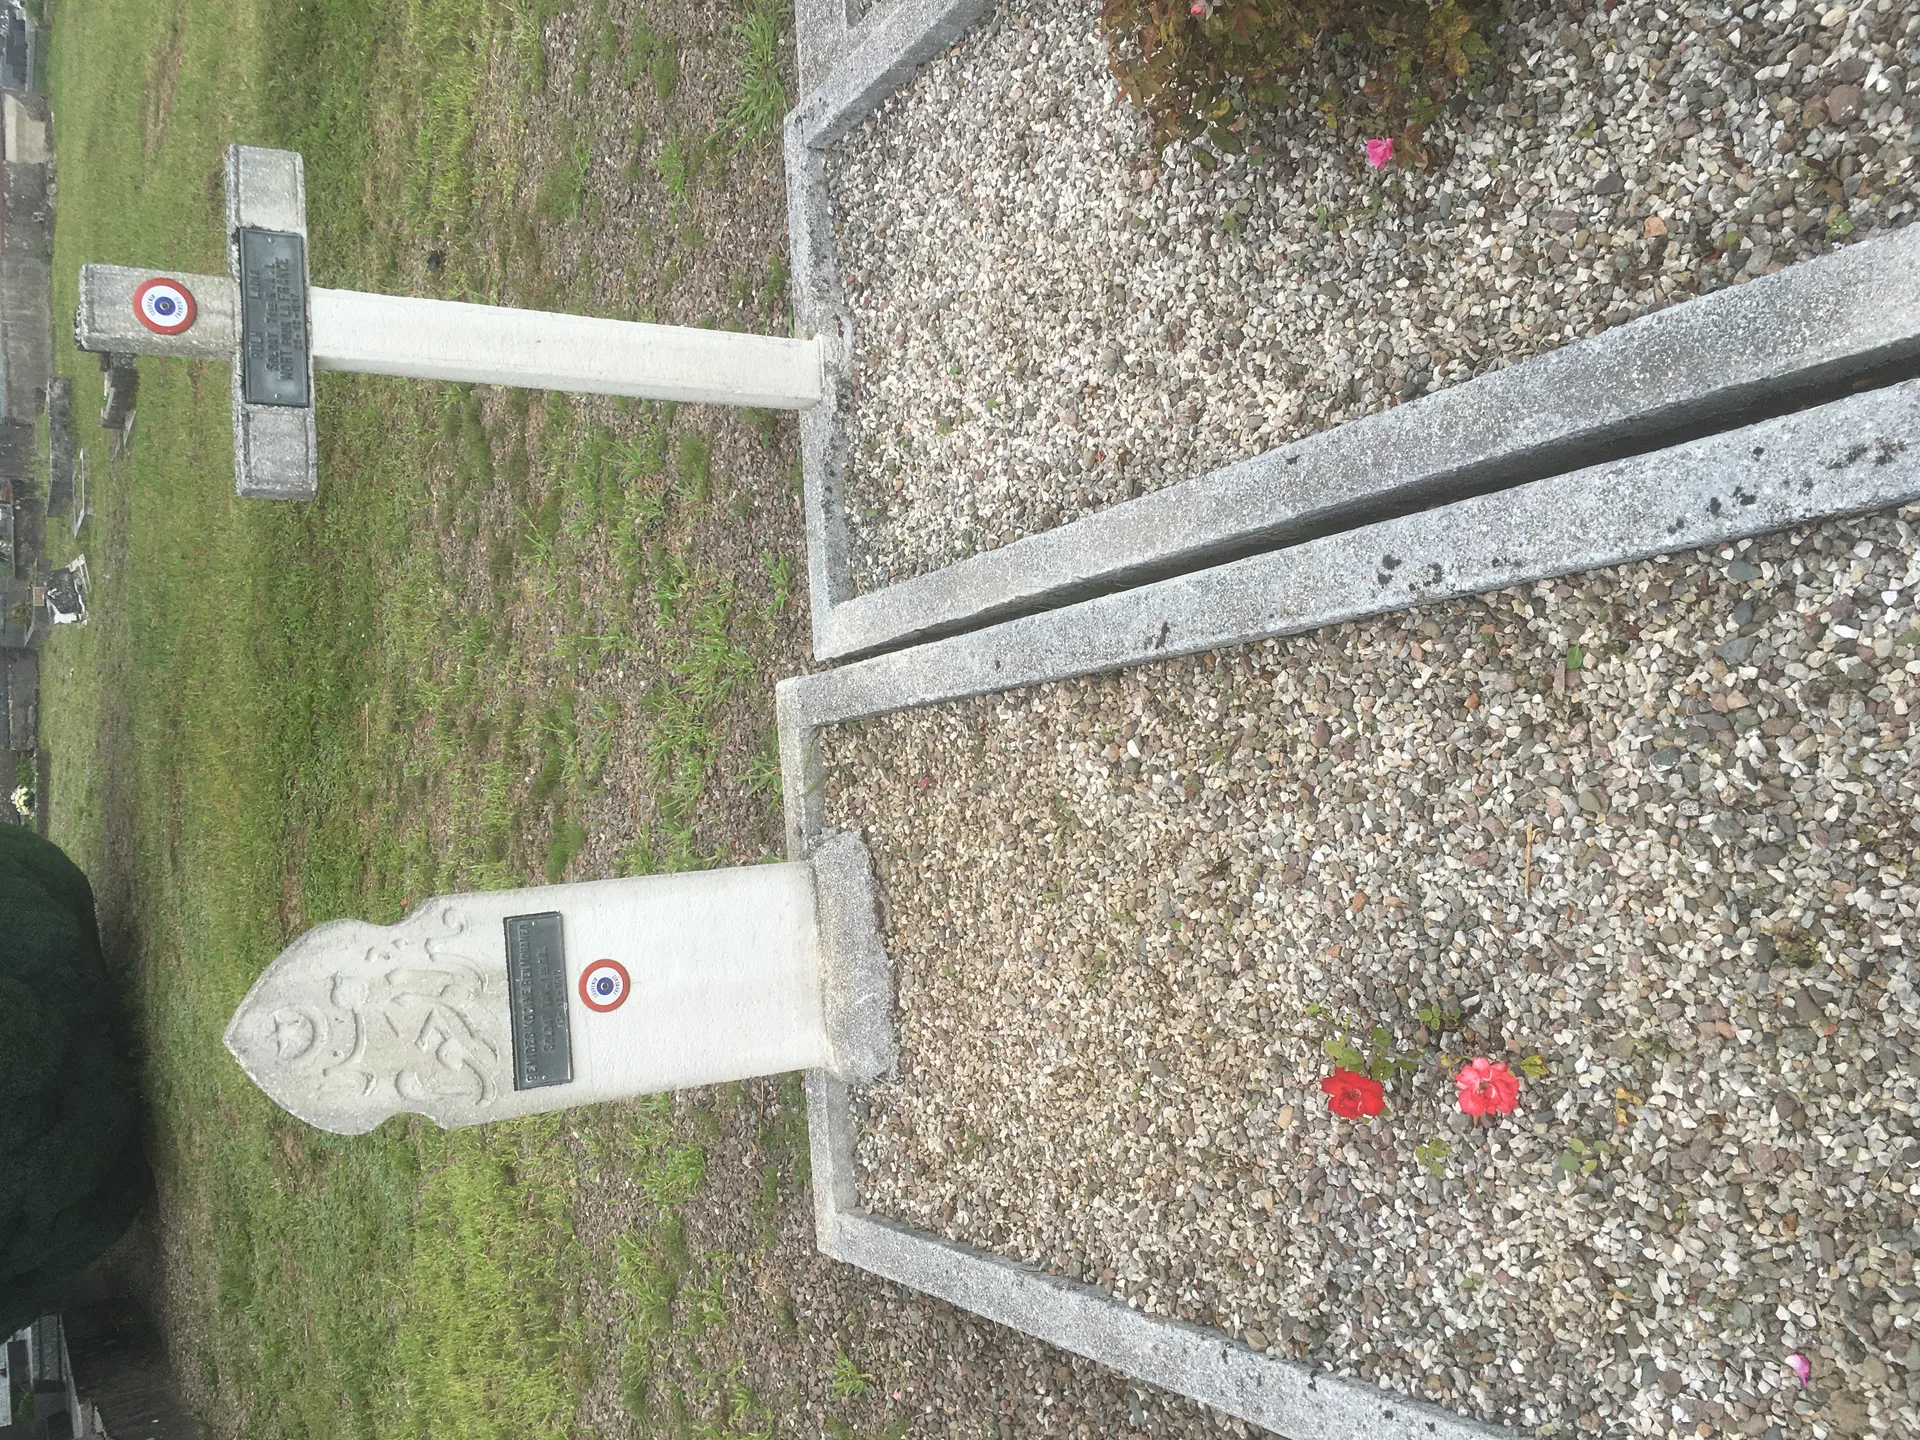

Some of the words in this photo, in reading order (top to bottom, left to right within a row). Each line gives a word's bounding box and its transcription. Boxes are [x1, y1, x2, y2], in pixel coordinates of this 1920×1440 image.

[275, 257, 290, 301] FRANCE
[146, 294, 156, 316] SOUVENIR
[278, 305, 291, 317] LA
[279, 321, 292, 346] POUR
[265, 332, 279, 371] SOLDAT
[279, 349, 293, 380] MORT
[518, 924, 531, 966] MOHAMED
[520, 965, 533, 986] BEN
[590, 977, 598, 998] SOUVENIR
[541, 1015, 556, 1052] SOLDAT
